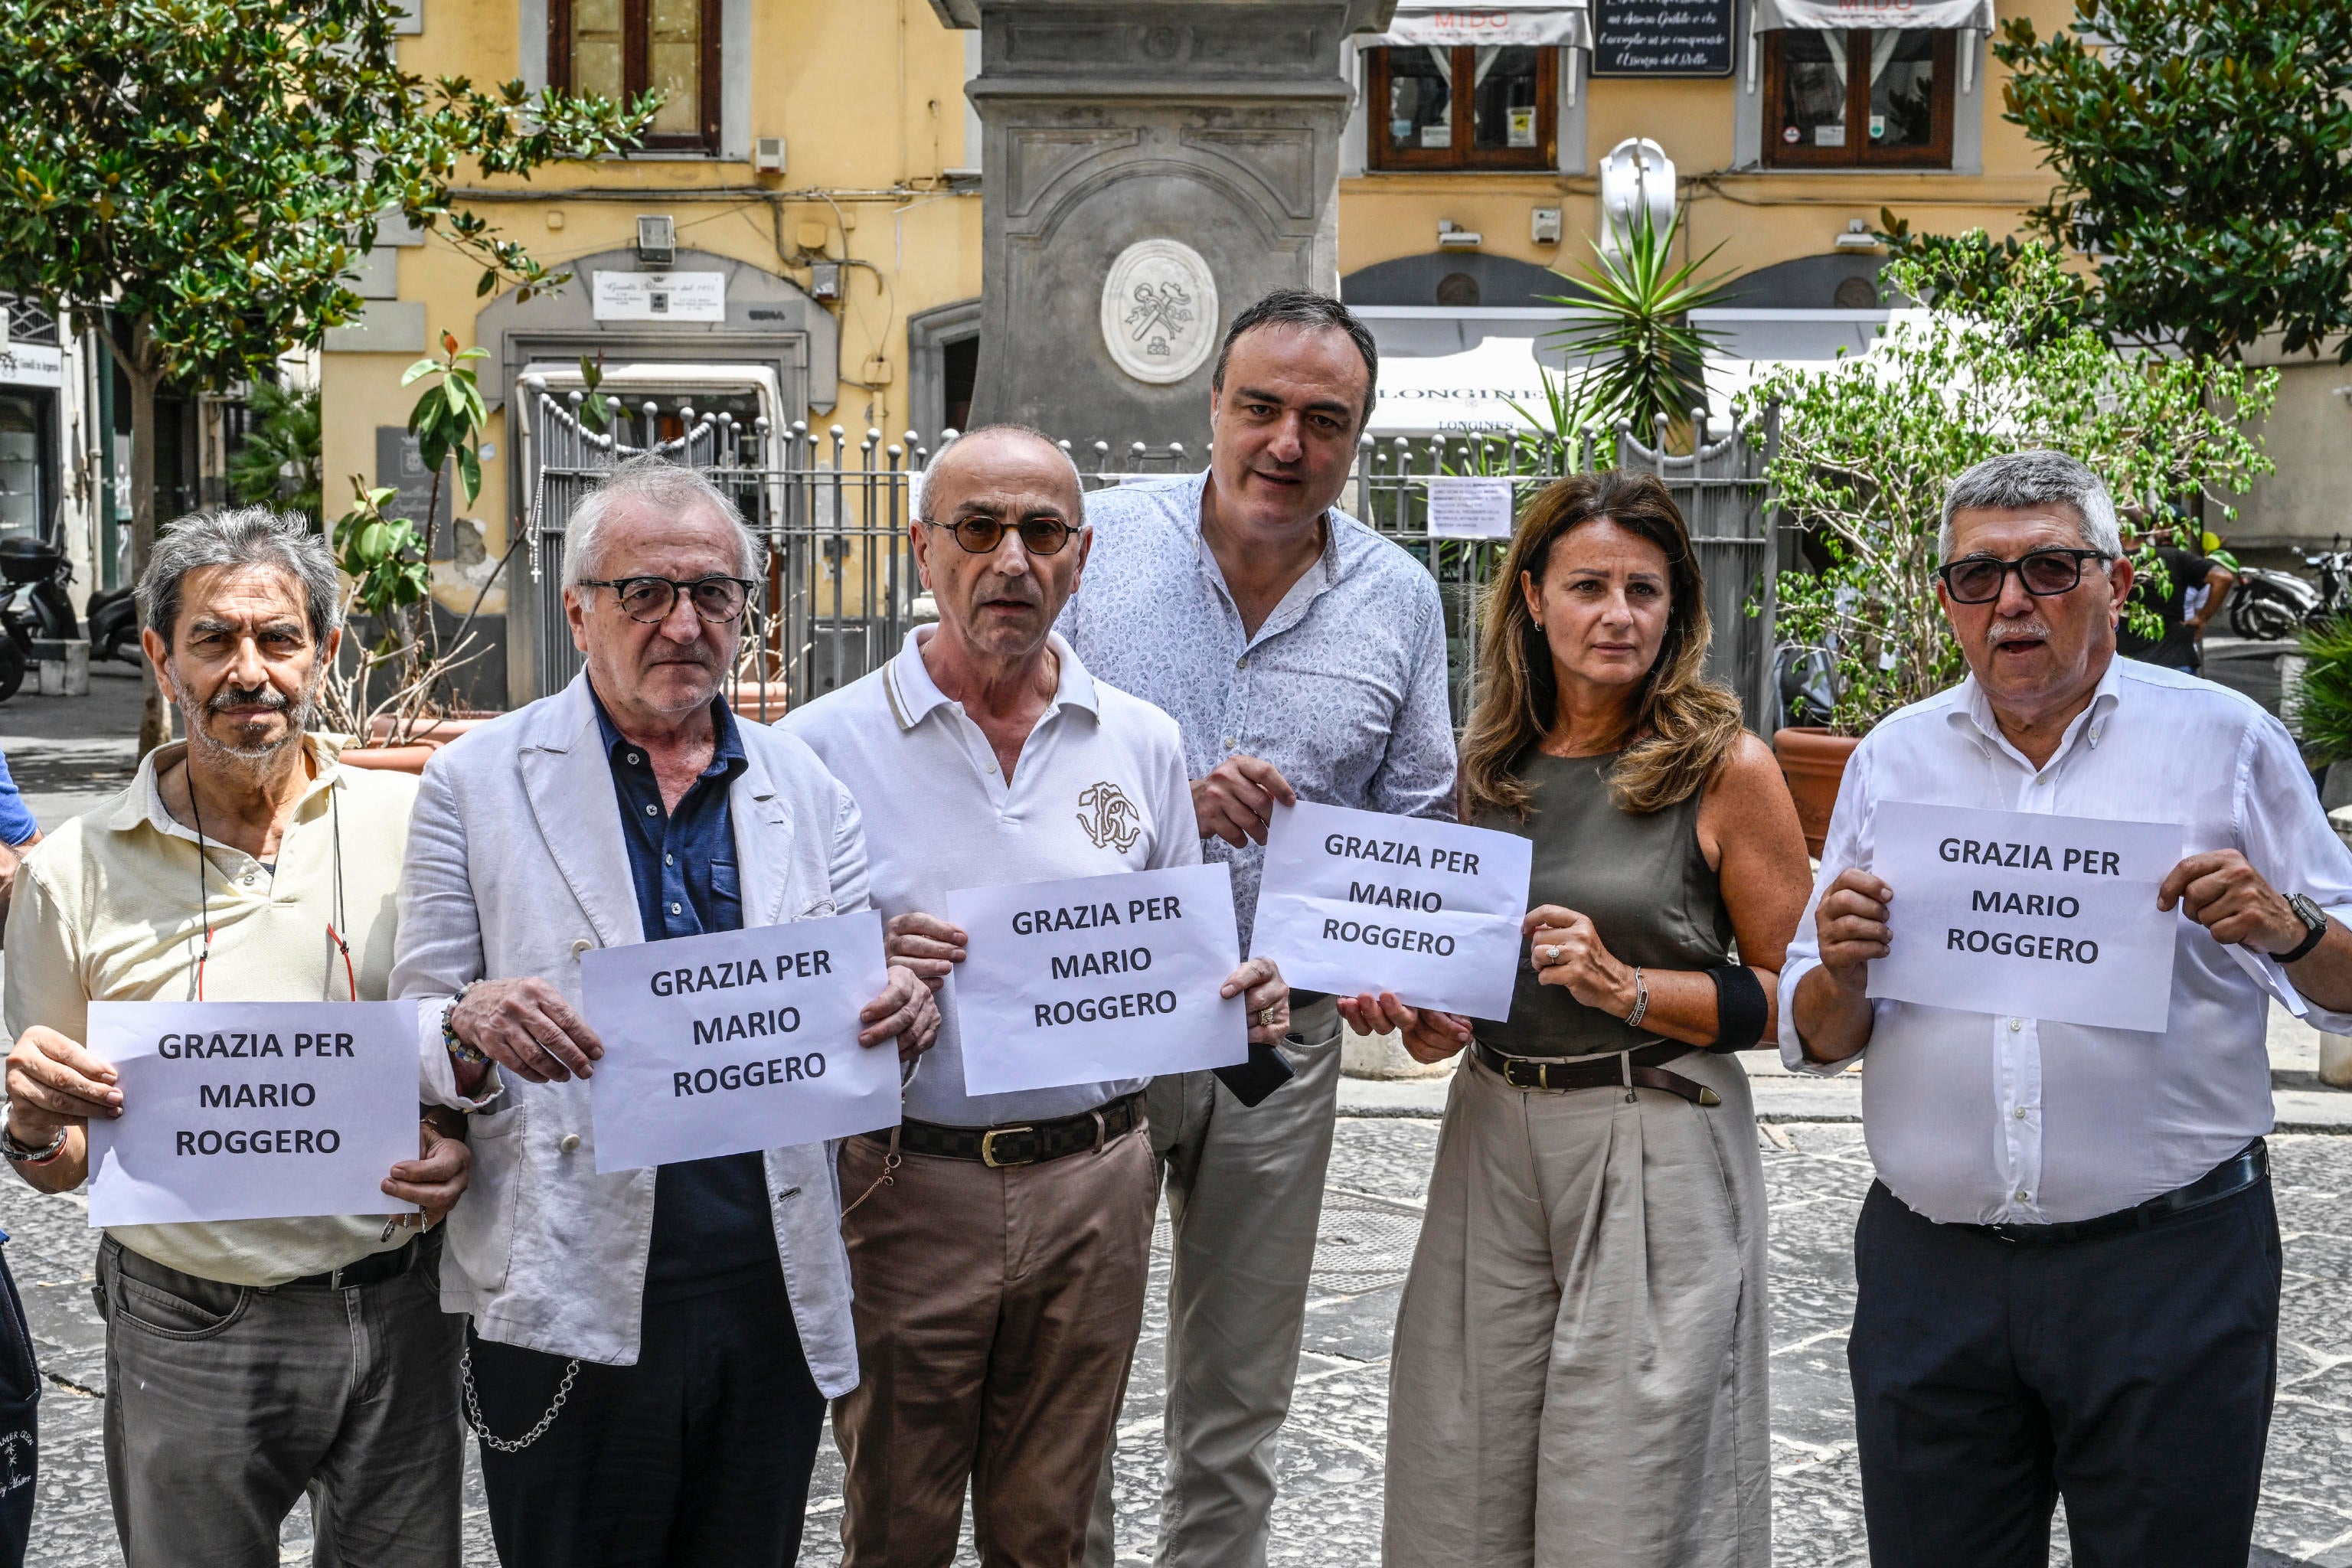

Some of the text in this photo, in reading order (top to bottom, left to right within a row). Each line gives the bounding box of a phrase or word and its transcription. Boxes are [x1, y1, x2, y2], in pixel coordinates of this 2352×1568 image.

[1435, 11, 1508, 28] MIDO
[1439, 421, 1514, 430] LONGINES
[1325, 835, 1478, 874] GRAZIA PER
[1939, 838, 2119, 875] GRAZIA PER
[1350, 882, 1442, 913] MARIO
[1972, 890, 2079, 918] MARIO
[1013, 897, 1181, 935] GRAZIA PER
[1323, 920, 1455, 956] ROGGERO
[1948, 929, 2098, 964] ROGGERO
[651, 950, 831, 996] GRAZIA PER
[1052, 948, 1151, 979] MARIO
[694, 1007, 800, 1045] MARIO
[1035, 991, 1176, 1027] ROGGERO
[158, 1034, 354, 1059] GRAZIA PER
[674, 1053, 825, 1096] ROGGERO
[201, 1083, 315, 1107] MARIO
[177, 1129, 340, 1155] ROGGERO
